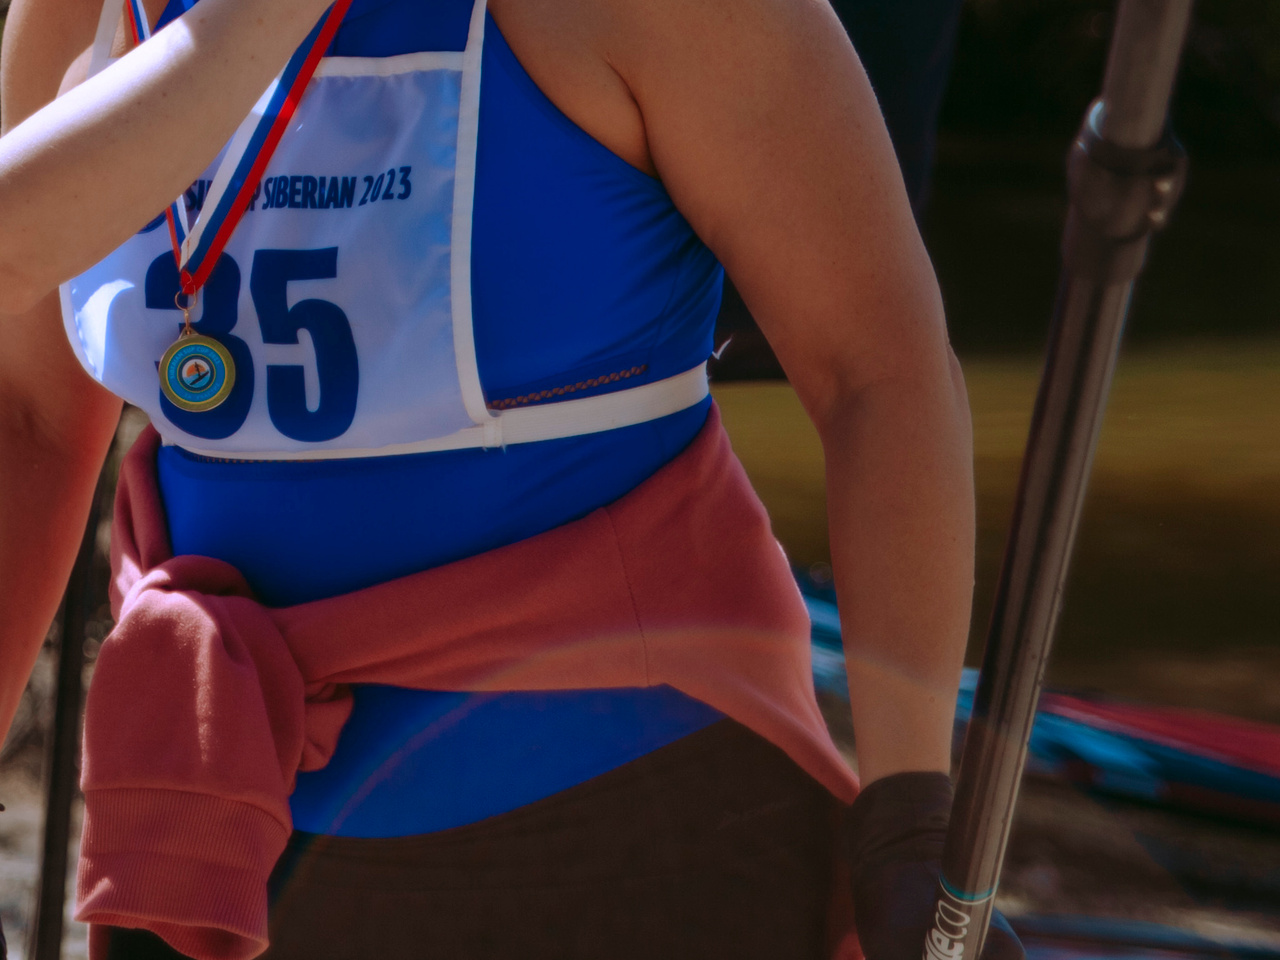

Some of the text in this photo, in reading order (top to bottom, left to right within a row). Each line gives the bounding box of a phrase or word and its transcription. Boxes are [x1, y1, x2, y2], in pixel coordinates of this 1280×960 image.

[262, 175, 358, 210] SIBERIAN
[358, 166, 412, 207] 2023
[145, 246, 359, 443] 35
